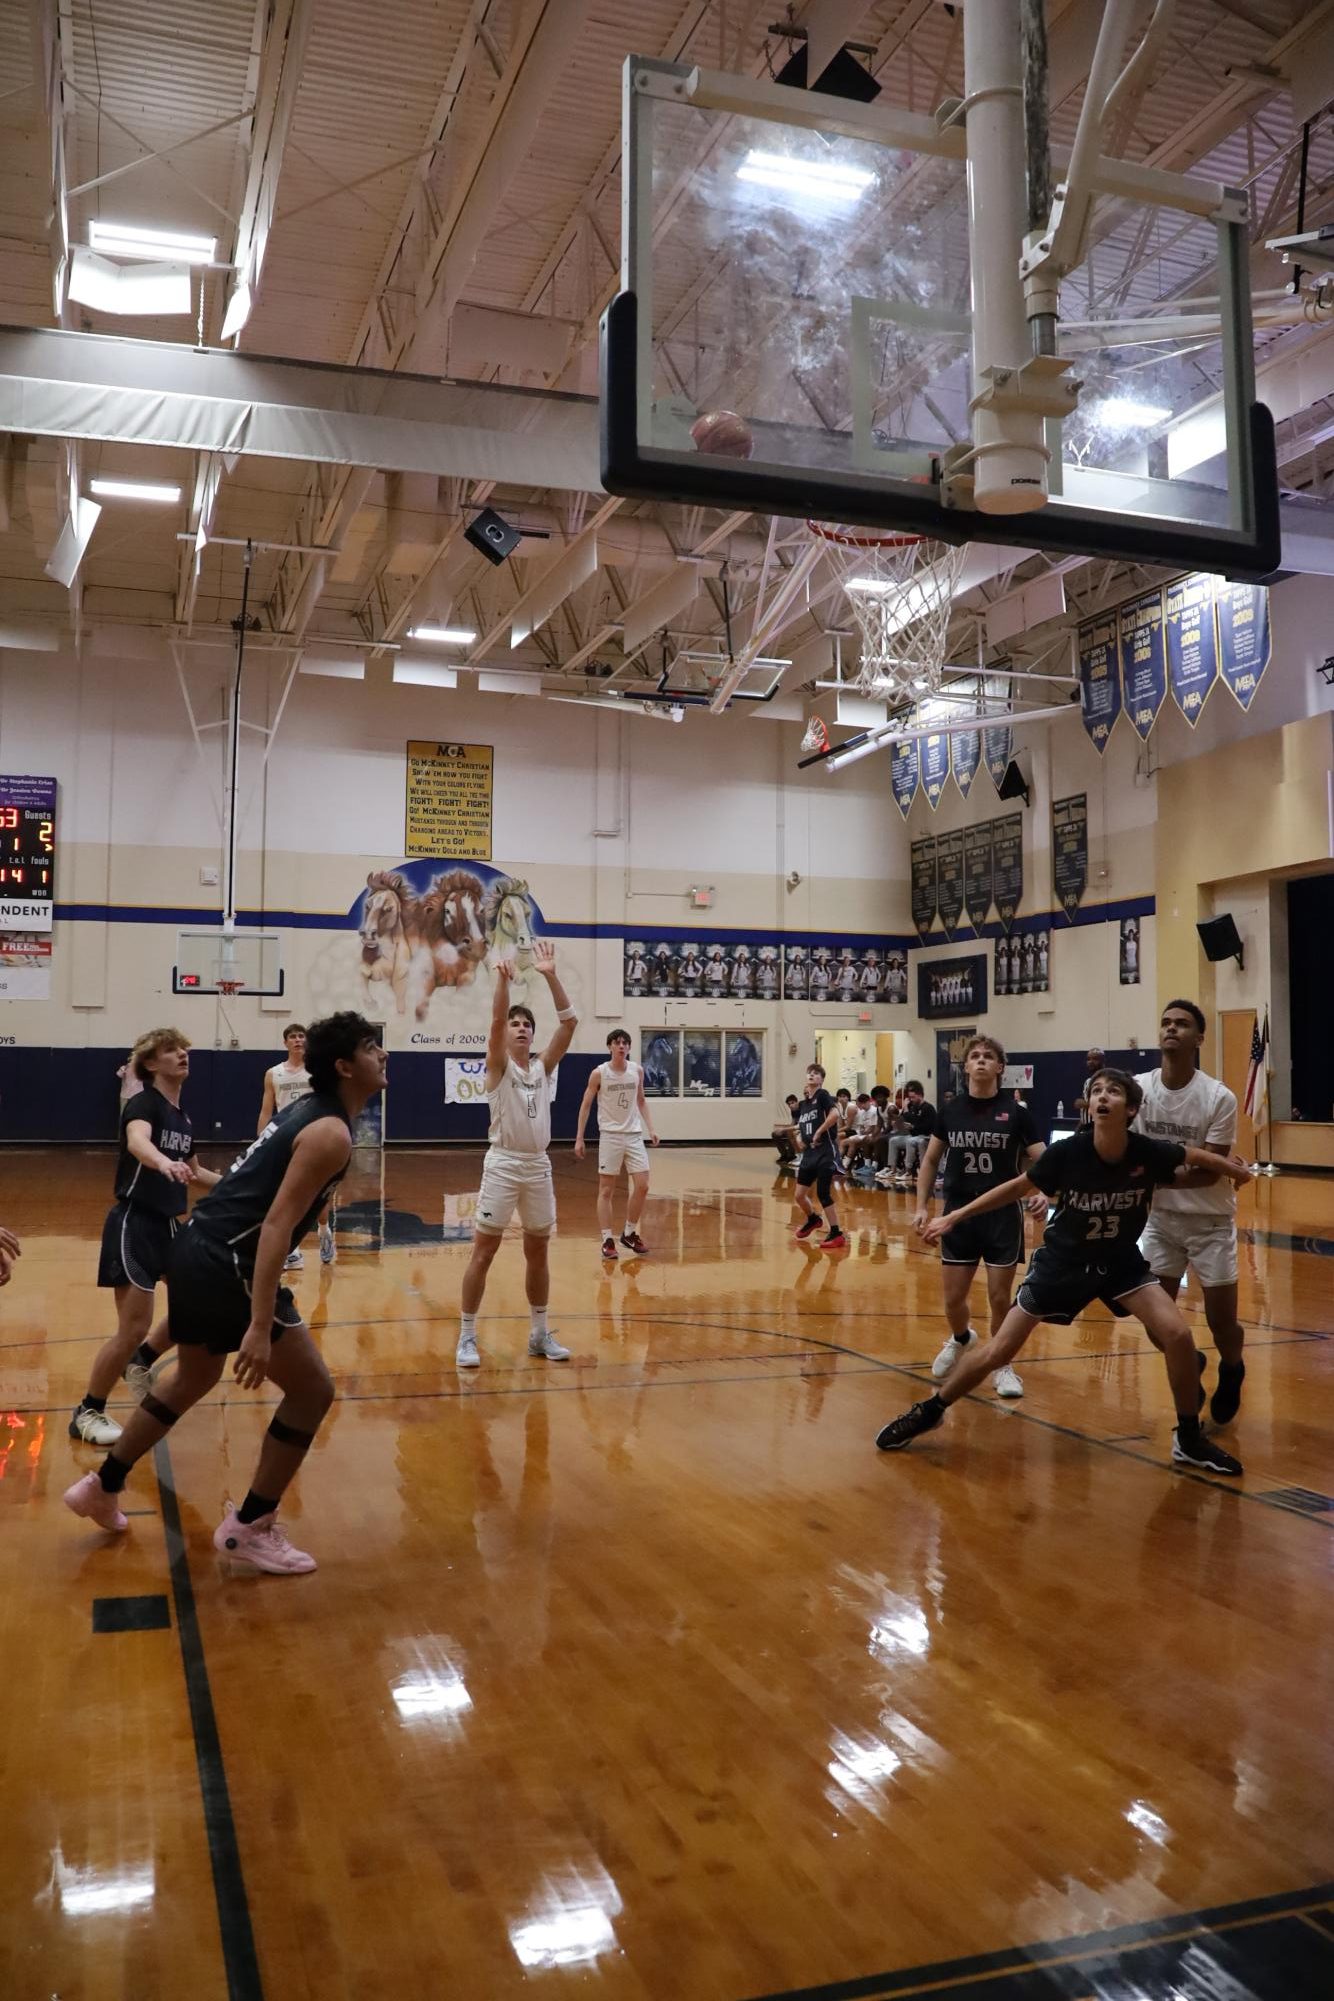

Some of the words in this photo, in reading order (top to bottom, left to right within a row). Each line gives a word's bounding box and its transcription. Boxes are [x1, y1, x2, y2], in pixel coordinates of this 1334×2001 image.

[411, 1033, 441, 1044] Class
[446, 1034, 455, 1045] of
[459, 1034, 486, 1044] 2009
[458, 1062, 487, 1075] W
[527, 1094, 537, 1118] 5
[617, 1092, 629, 1109] 4
[947, 1131, 1011, 1150] HARVEST
[964, 1152, 993, 1174] 20
[1069, 1188, 1146, 1212] HARVEST
[1086, 1215, 1121, 1240] 23
